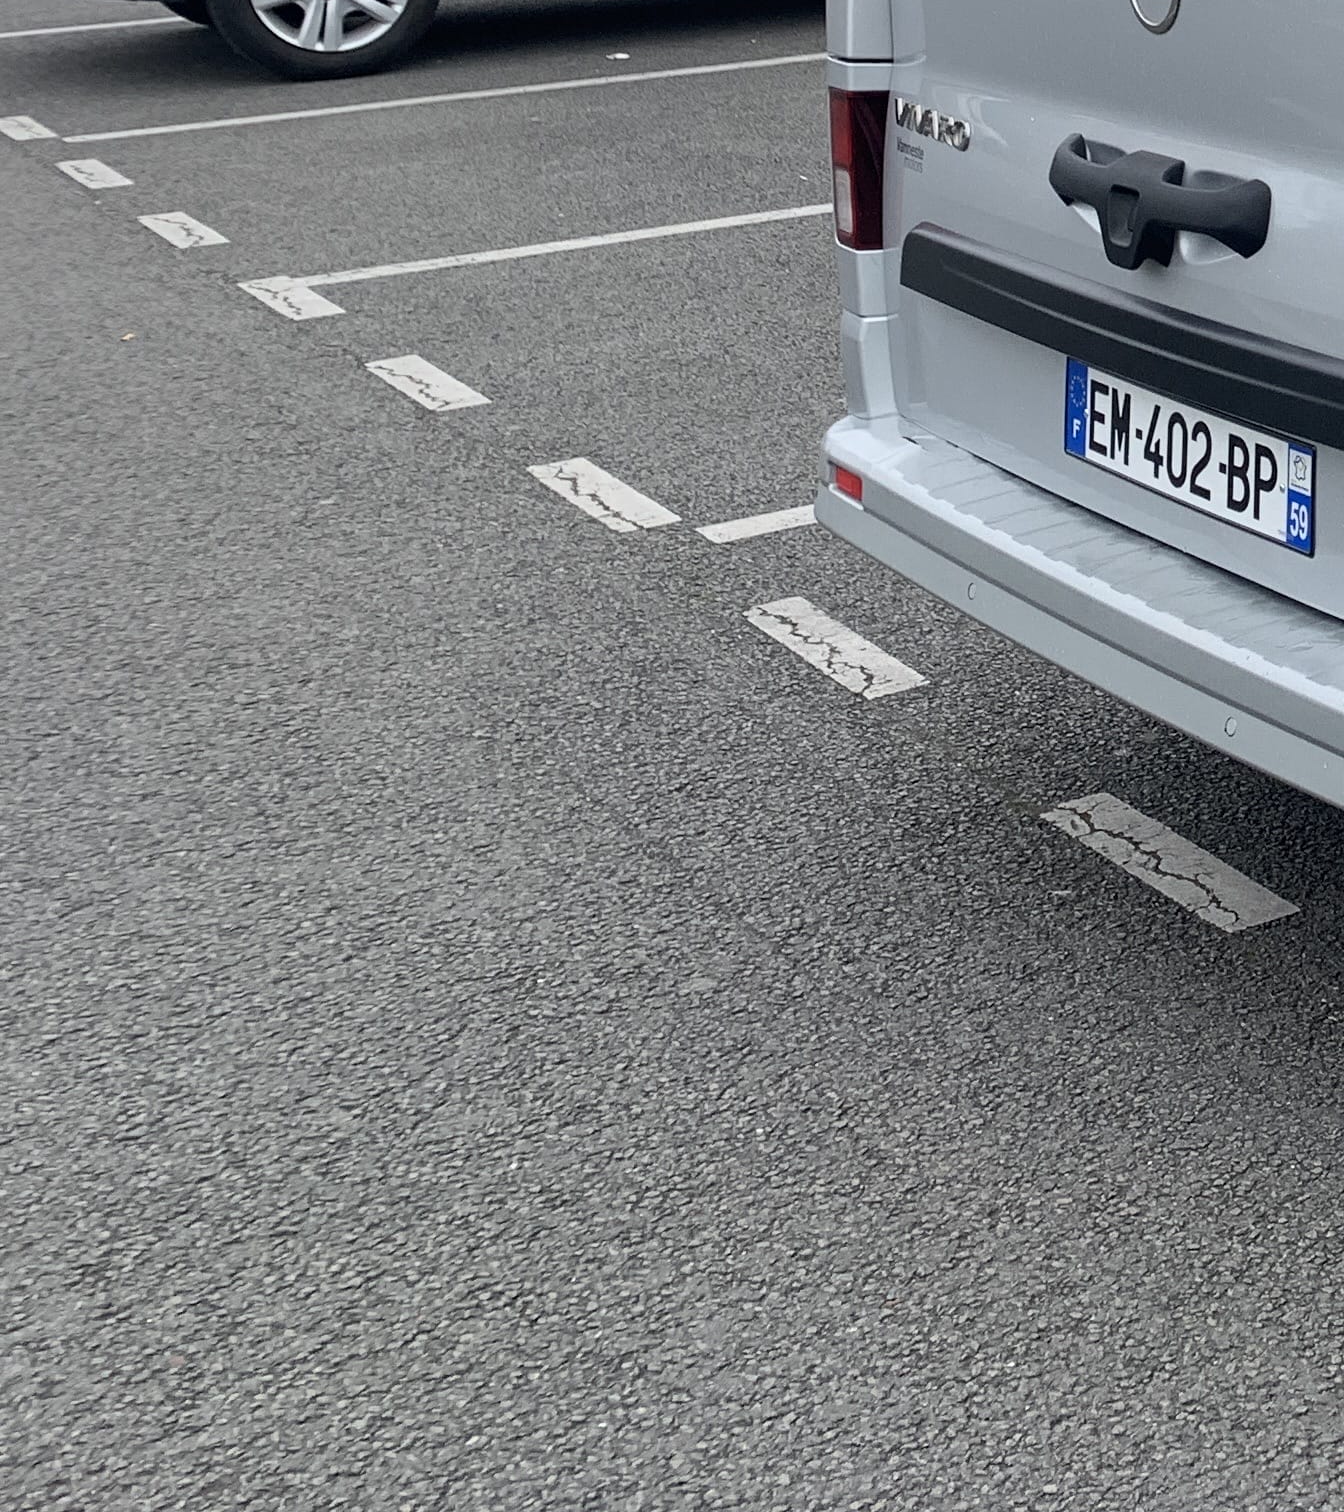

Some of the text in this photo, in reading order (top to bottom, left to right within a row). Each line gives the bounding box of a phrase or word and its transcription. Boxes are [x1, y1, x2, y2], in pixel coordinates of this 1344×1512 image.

[1072, 419, 1081, 438] F
[1089, 379, 1277, 520] EM-402-BP
[1289, 501, 1308, 540] 59
